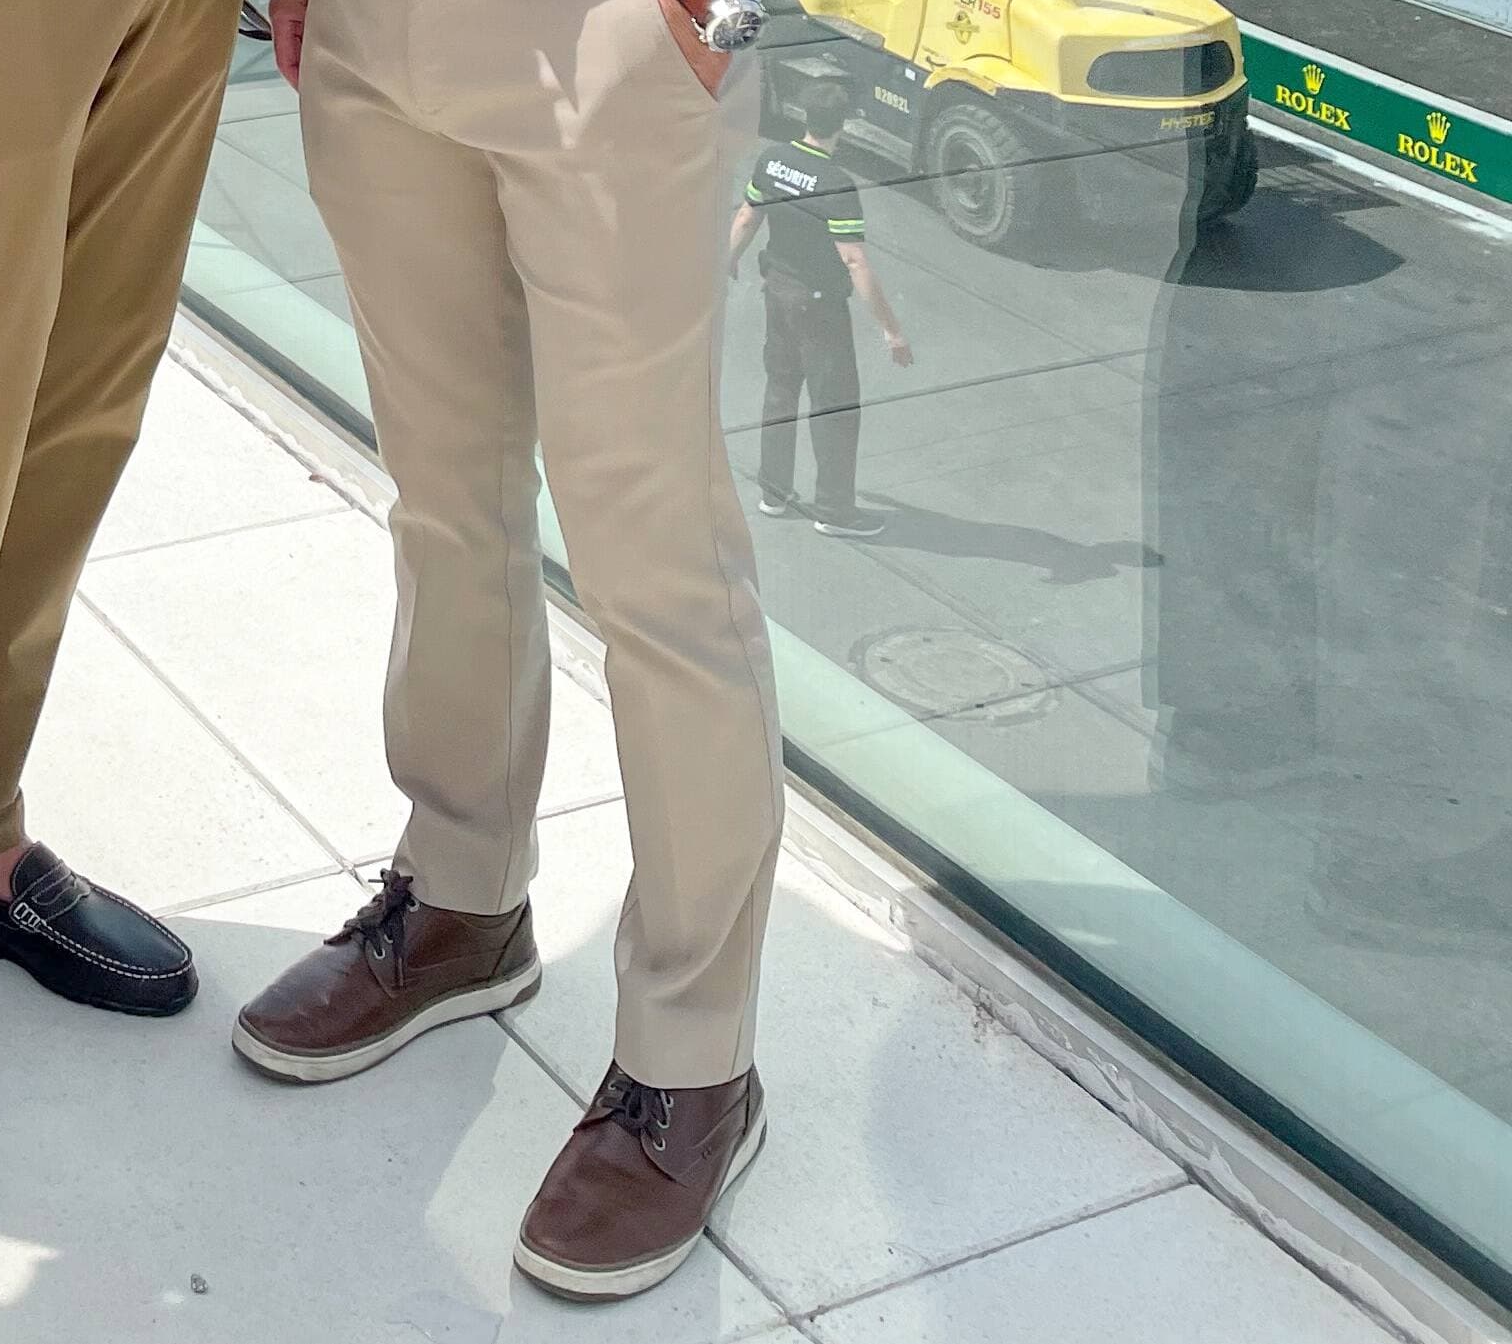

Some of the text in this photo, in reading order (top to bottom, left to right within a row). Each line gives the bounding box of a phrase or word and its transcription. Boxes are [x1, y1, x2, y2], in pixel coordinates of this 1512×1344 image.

[1275, 84, 1352, 132] ROLEX
[766, 160, 818, 192] SÉCURITÉ
[1397, 133, 1479, 184] ROLEX
